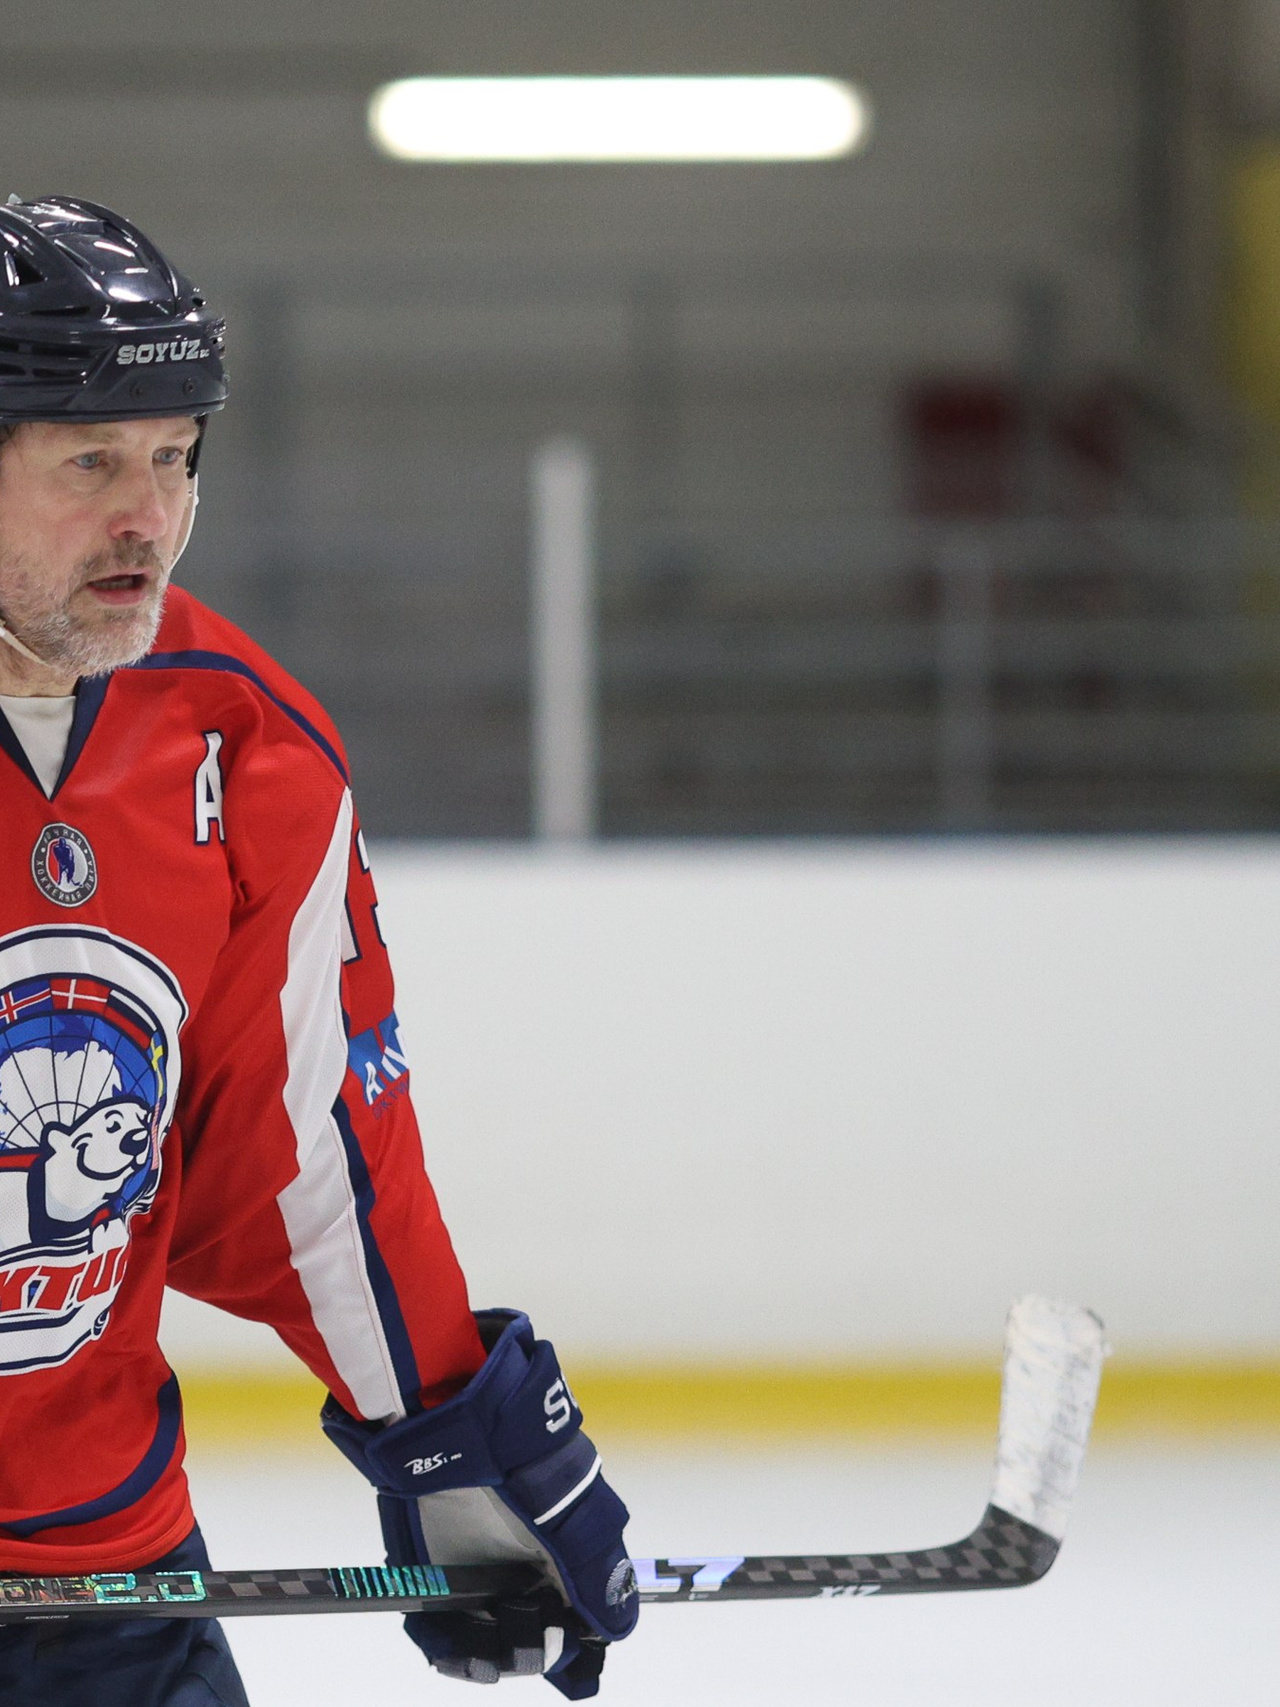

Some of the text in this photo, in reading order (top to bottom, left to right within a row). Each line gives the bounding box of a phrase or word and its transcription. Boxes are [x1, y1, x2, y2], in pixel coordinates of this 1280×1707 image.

[116, 339, 201, 364] SOYUZ
[194, 729, 226, 844] A
[543, 1374, 577, 1434] S
[403, 1452, 445, 1475] BBS
